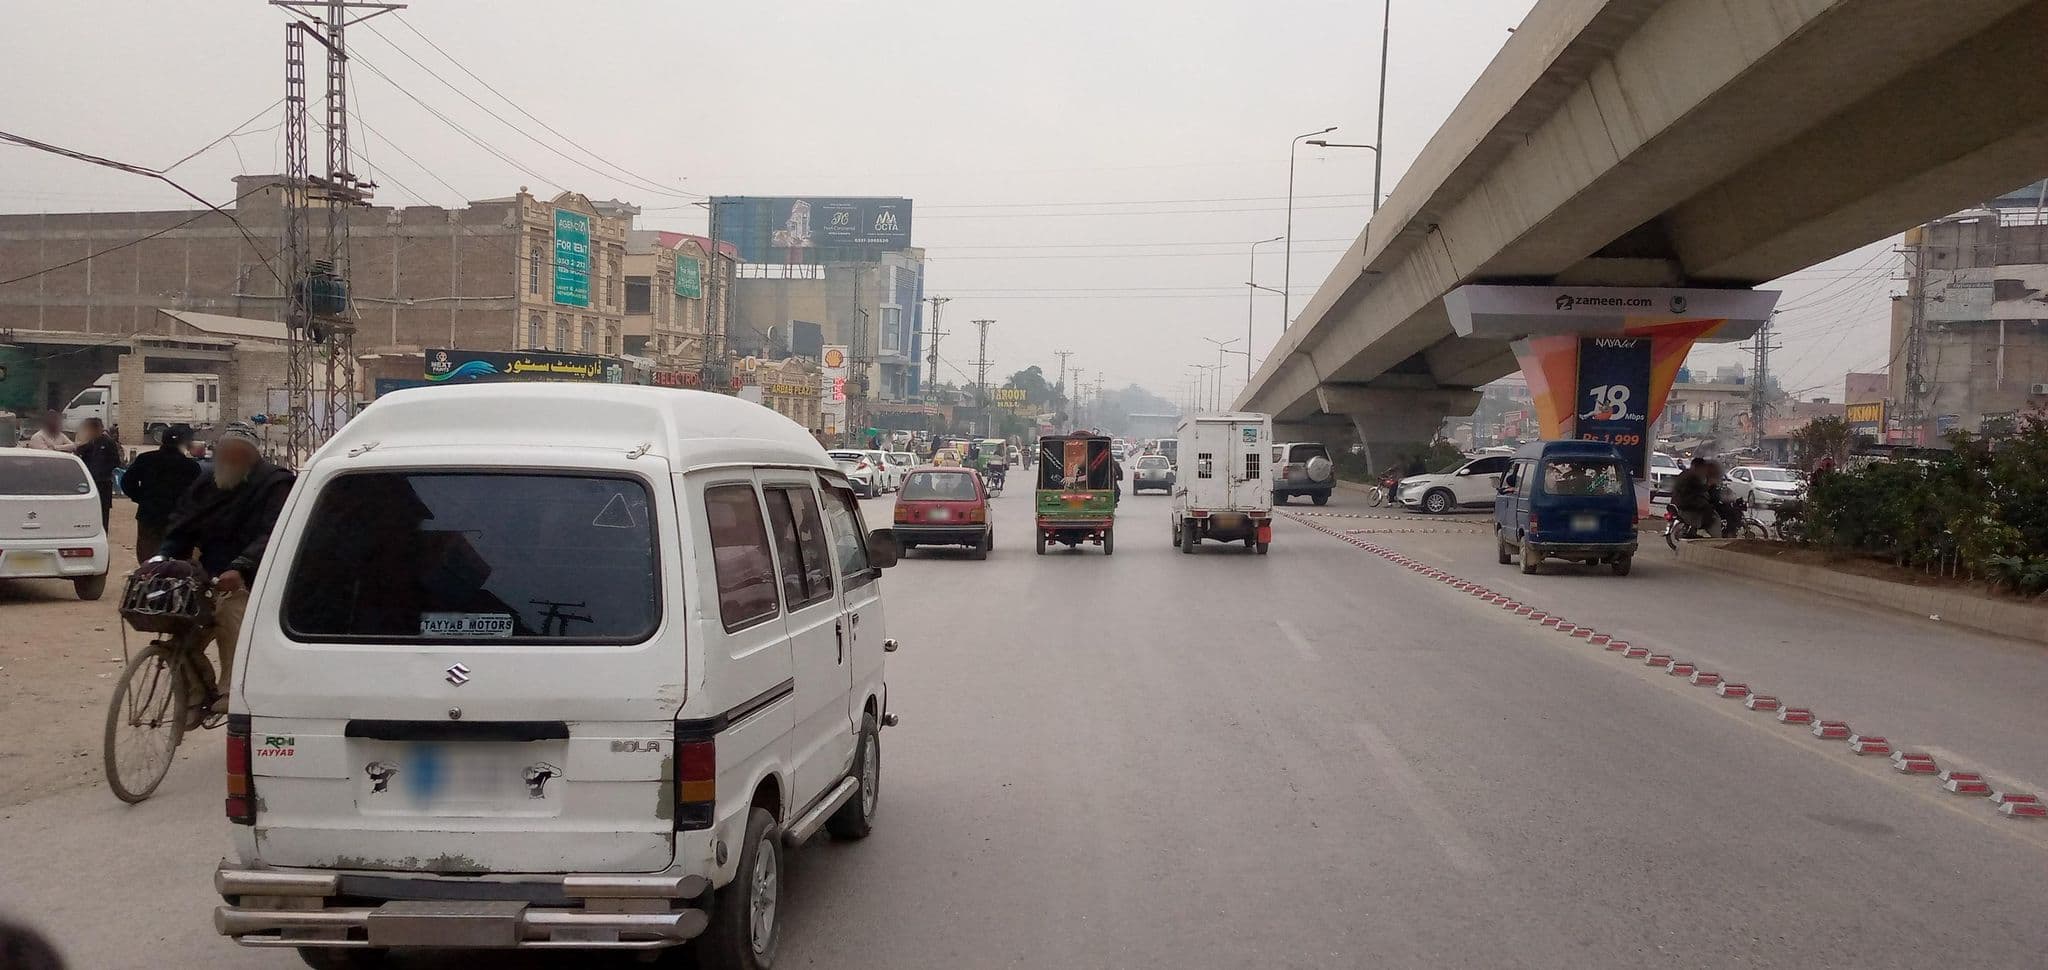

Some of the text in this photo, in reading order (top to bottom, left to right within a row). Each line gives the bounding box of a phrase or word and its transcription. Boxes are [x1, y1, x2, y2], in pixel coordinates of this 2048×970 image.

[874, 223, 899, 231] OCTA
[556, 240, 572, 251] FOR
[1575, 296, 1653, 307] zameen.com
[1589, 384, 1630, 420] 18
[1624, 414, 1645, 422] Mbps
[424, 620, 512, 630] TAYYAB MOTORS
[256, 749, 295, 757] TAYYAB
